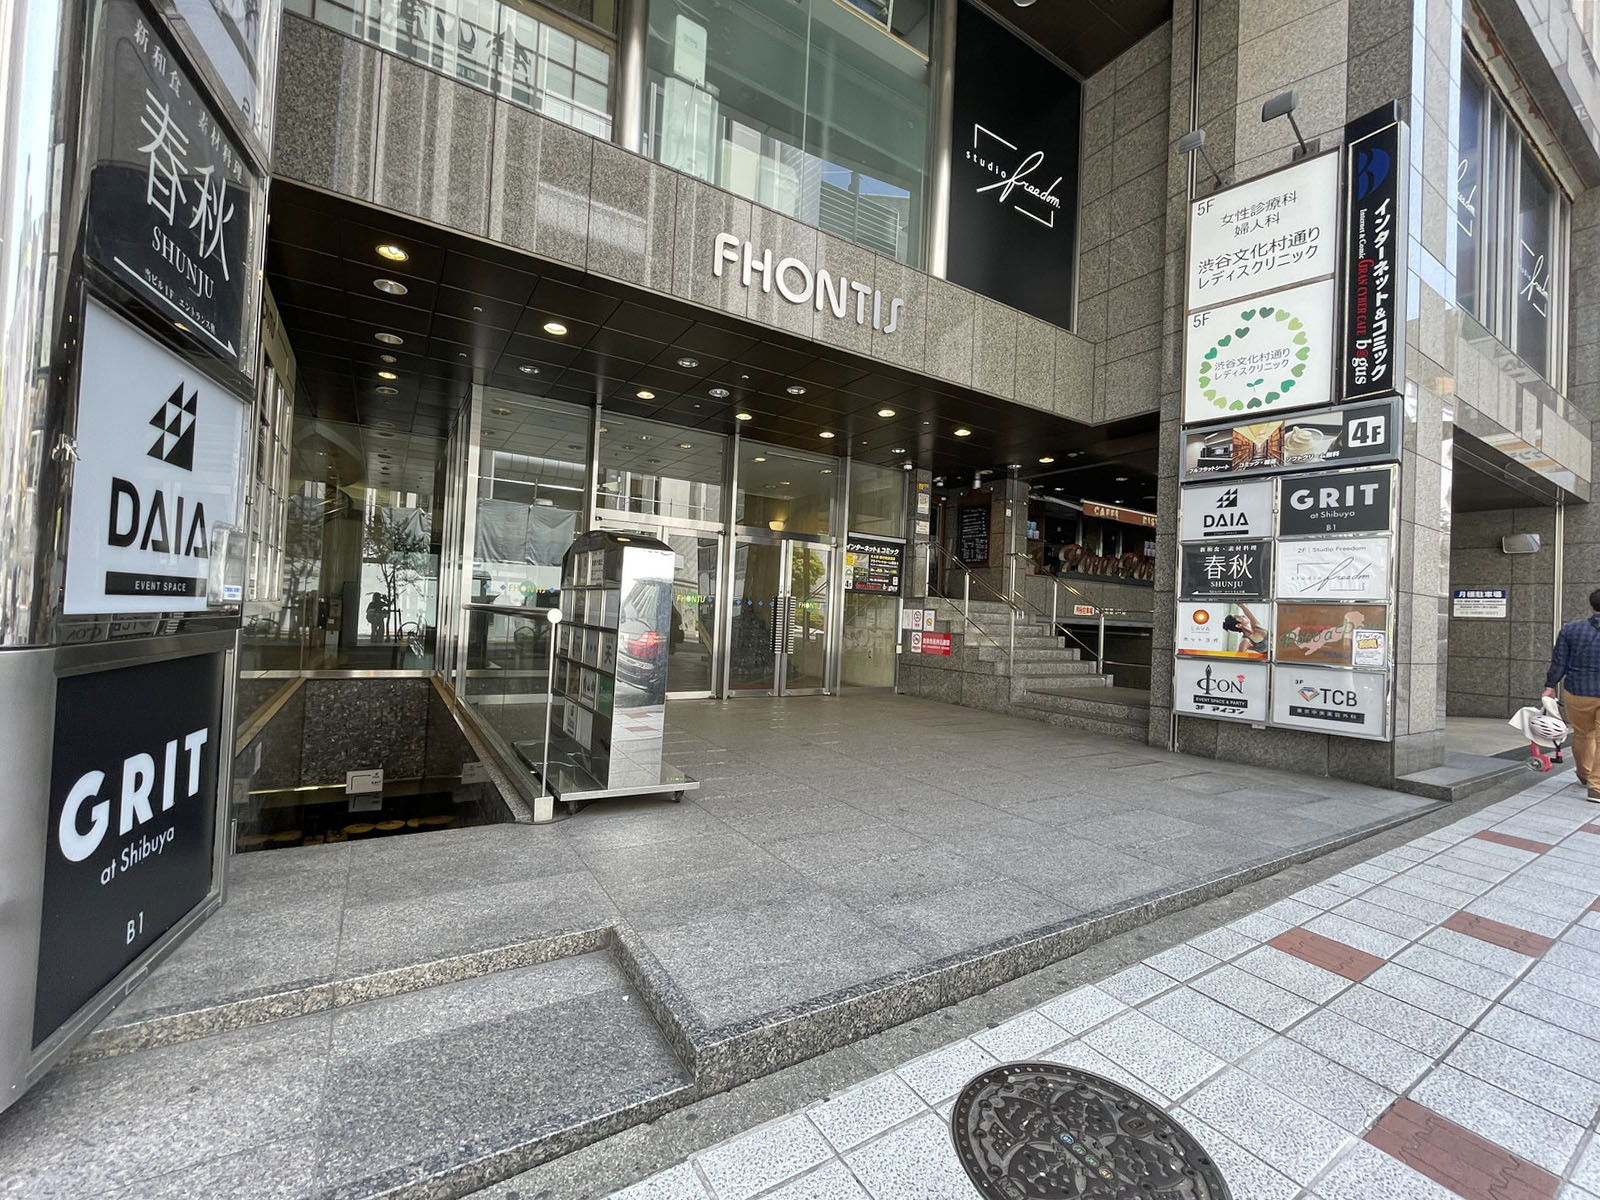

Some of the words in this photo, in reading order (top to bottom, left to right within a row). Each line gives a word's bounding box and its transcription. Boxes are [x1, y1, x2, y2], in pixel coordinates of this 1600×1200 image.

[966, 151, 1007, 178] studio
[138, 88, 235, 281] 春秋
[1197, 198, 1215, 216] 5F
[1221, 190, 1297, 227] 女性診療科
[1234, 211, 1280, 237] 婦人科
[152, 225, 215, 298] SHUNJU
[1198, 226, 1320, 274] 渋谷文化村通り
[1198, 245, 1319, 290] レディスクリニック
[713, 232, 905, 334] FHONTIS
[1193, 312, 1211, 328] 5F
[1214, 347, 1291, 371] 渋谷文化村通り
[1214, 359, 1290, 380] レディスクリニック
[1351, 420, 1384, 444] 4F
[1289, 483, 1380, 511] GRIT
[107, 476, 210, 560] DAIA
[1203, 512, 1249, 528] DAIA
[1310, 510, 1319, 519] at
[1320, 509, 1355, 519] Shibuya
[1326, 523, 1336, 532] B1
[1203, 554, 1253, 579] 春秋
[135, 579, 161, 591] EVENT
[163, 581, 187, 593] SPACE
[1210, 580, 1244, 590] SHUNJU
[1211, 705, 1246, 715] アイコン
[1319, 688, 1358, 707] TCB
[58, 727, 209, 863] GRIT
[100, 858, 117, 886] at
[120, 825, 176, 873] Shibuya
[126, 911, 145, 945] B1
